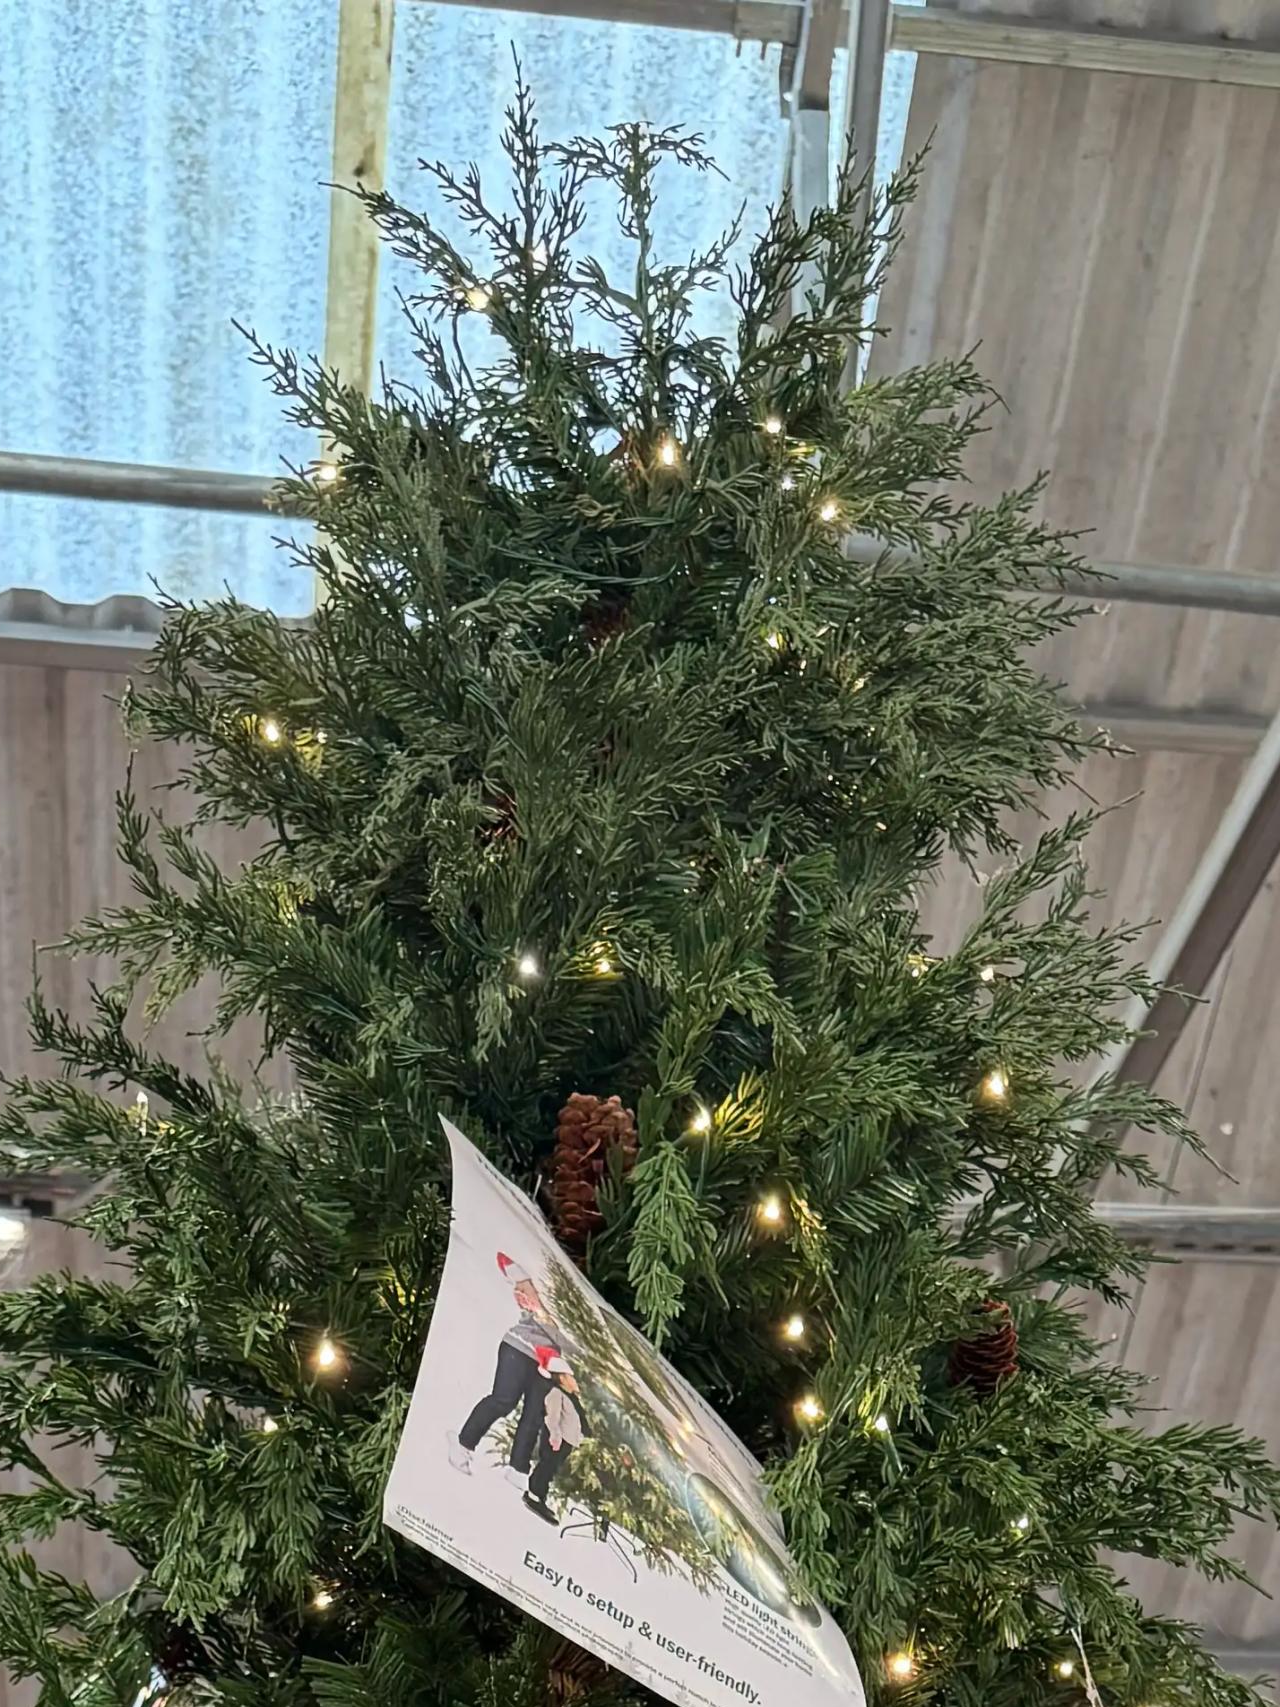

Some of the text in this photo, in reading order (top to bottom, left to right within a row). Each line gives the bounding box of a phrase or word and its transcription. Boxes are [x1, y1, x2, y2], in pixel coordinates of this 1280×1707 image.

[523, 1550, 565, 1587] Easy
[566, 1577, 583, 1597] to
[586, 1591, 635, 1629] setup
[638, 1621, 652, 1640] &
[656, 1633, 762, 1706] user-friendly.
[726, 1585, 749, 1607] LED
[752, 1603, 778, 1628] light
